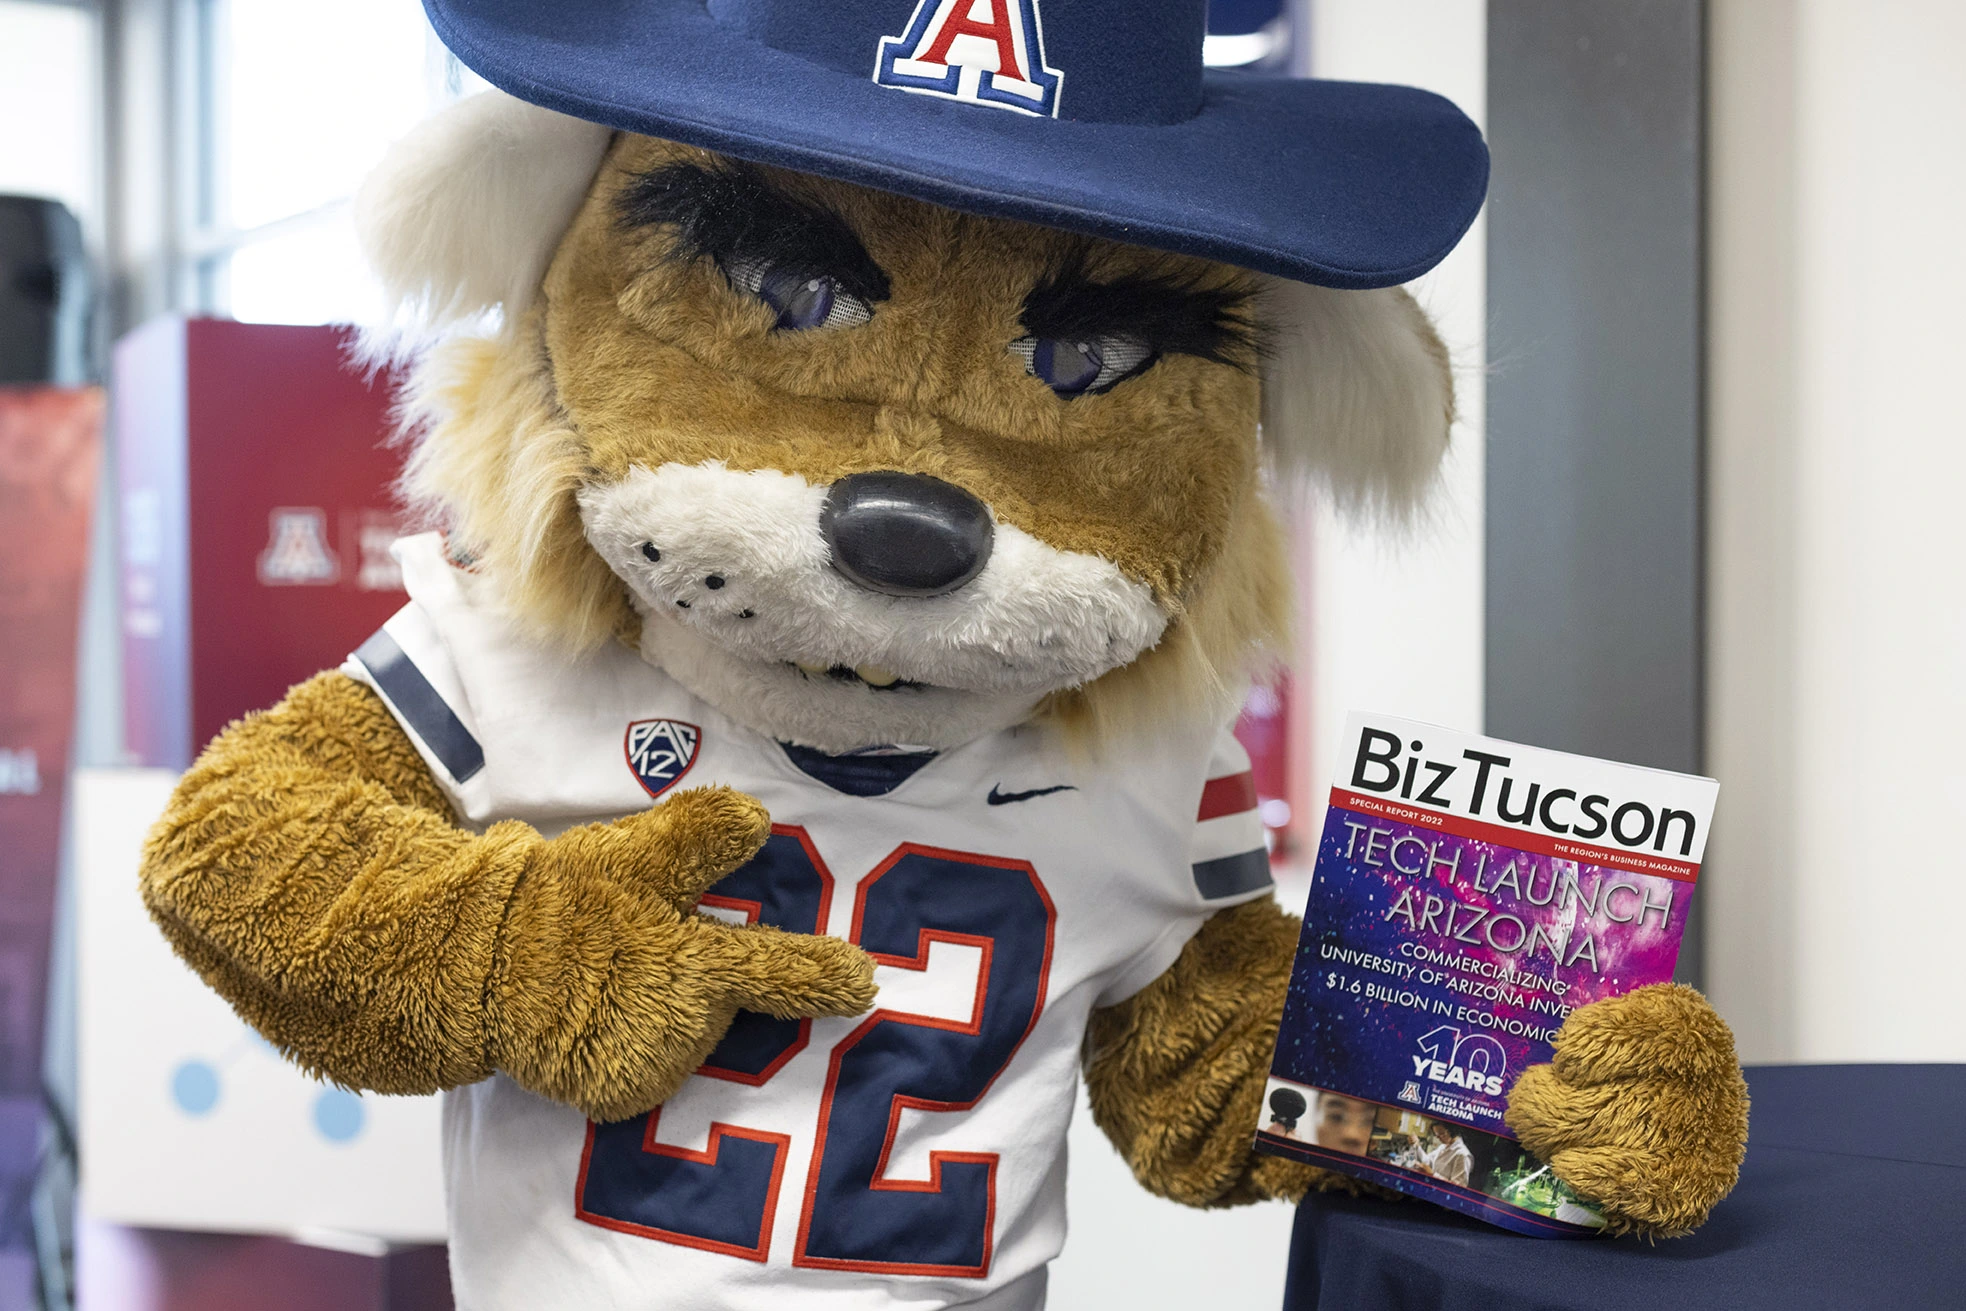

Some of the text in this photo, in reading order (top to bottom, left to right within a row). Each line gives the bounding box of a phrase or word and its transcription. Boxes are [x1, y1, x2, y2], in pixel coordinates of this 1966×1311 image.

[628, 720, 697, 768] PAC
[640, 750, 677, 779] 12
[1349, 798, 1444, 826] SPECIAL REPORT 2022
[1343, 821, 1675, 930] TECH LAUNCH
[1554, 843, 1691, 876] THE REGION'S BUSINESS MAGAZINE
[1384, 889, 1599, 974] ARIZONA
[1320, 943, 1576, 1020] UNIVERSITY OF ARIZONA INVE
[1400, 941, 1567, 996] COMMERCIALIZING
[1326, 971, 1558, 1044] $1.6 BILLION IN ECONOMIC
[1416, 1024, 1507, 1077] 10
[1412, 1055, 1504, 1096] YEARS
[1427, 1103, 1475, 1121] ARIZONA
[1430, 1093, 1458, 1108] TECH
[1459, 1101, 1503, 1120] LAUNCH
